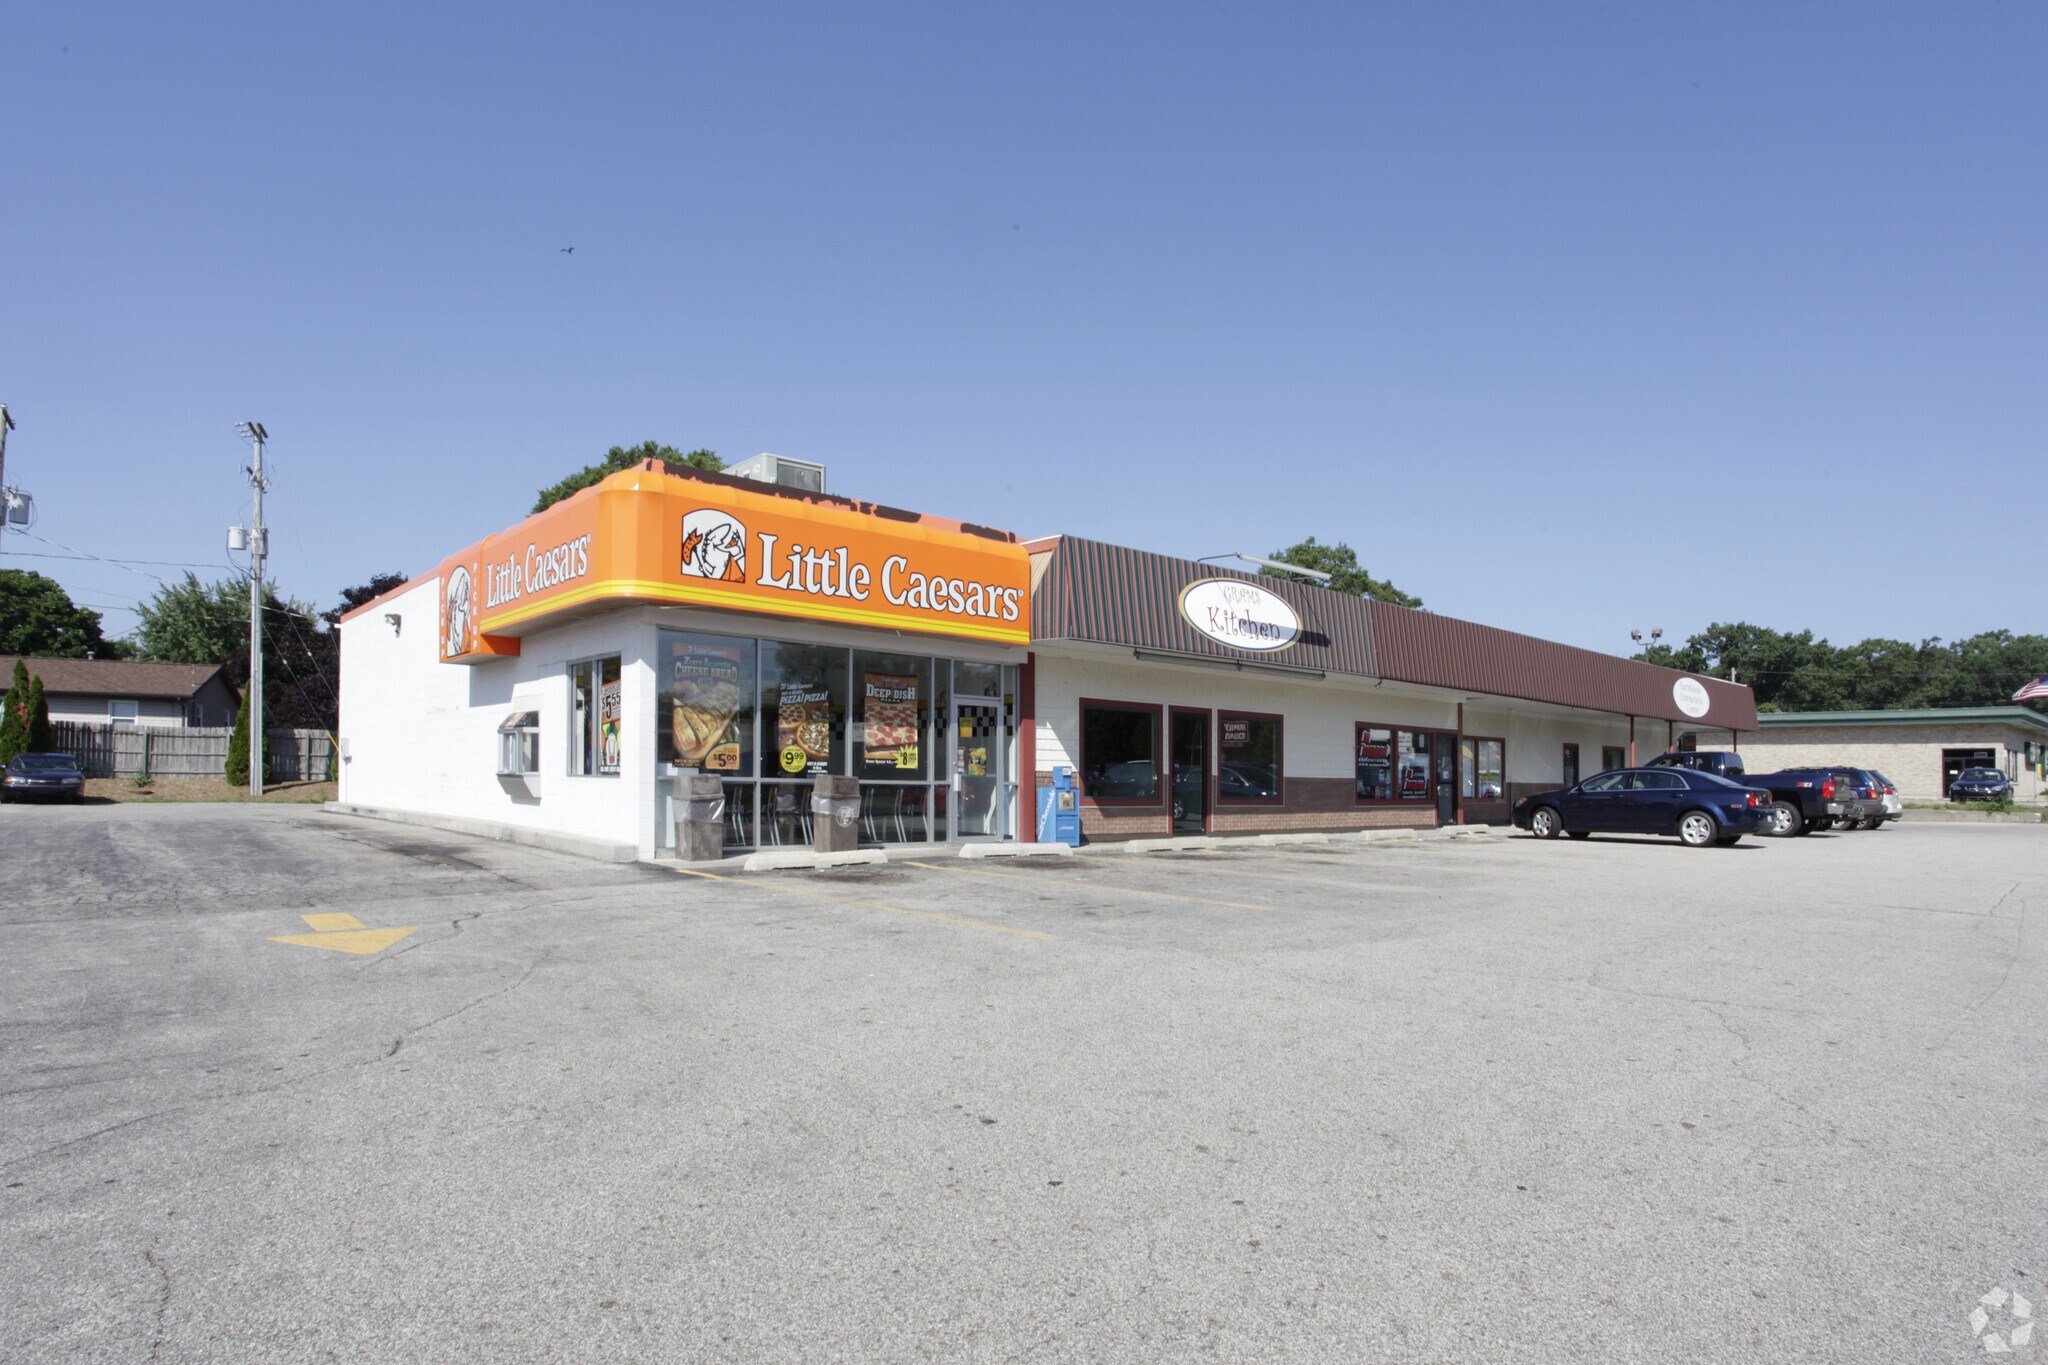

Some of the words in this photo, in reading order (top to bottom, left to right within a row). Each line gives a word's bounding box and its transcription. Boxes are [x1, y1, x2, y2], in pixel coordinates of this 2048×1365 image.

[486, 552, 522, 609] Little
[525, 534, 588, 594] Caesars
[756, 532, 870, 600] Little
[881, 555, 1019, 621] Caesars
[1207, 606, 1280, 641] Kitchen
[675, 661, 709, 679] CHEESE
[711, 666, 738, 683] BREAD
[866, 683, 891, 698] DEEP
[894, 686, 916, 700] DISH
